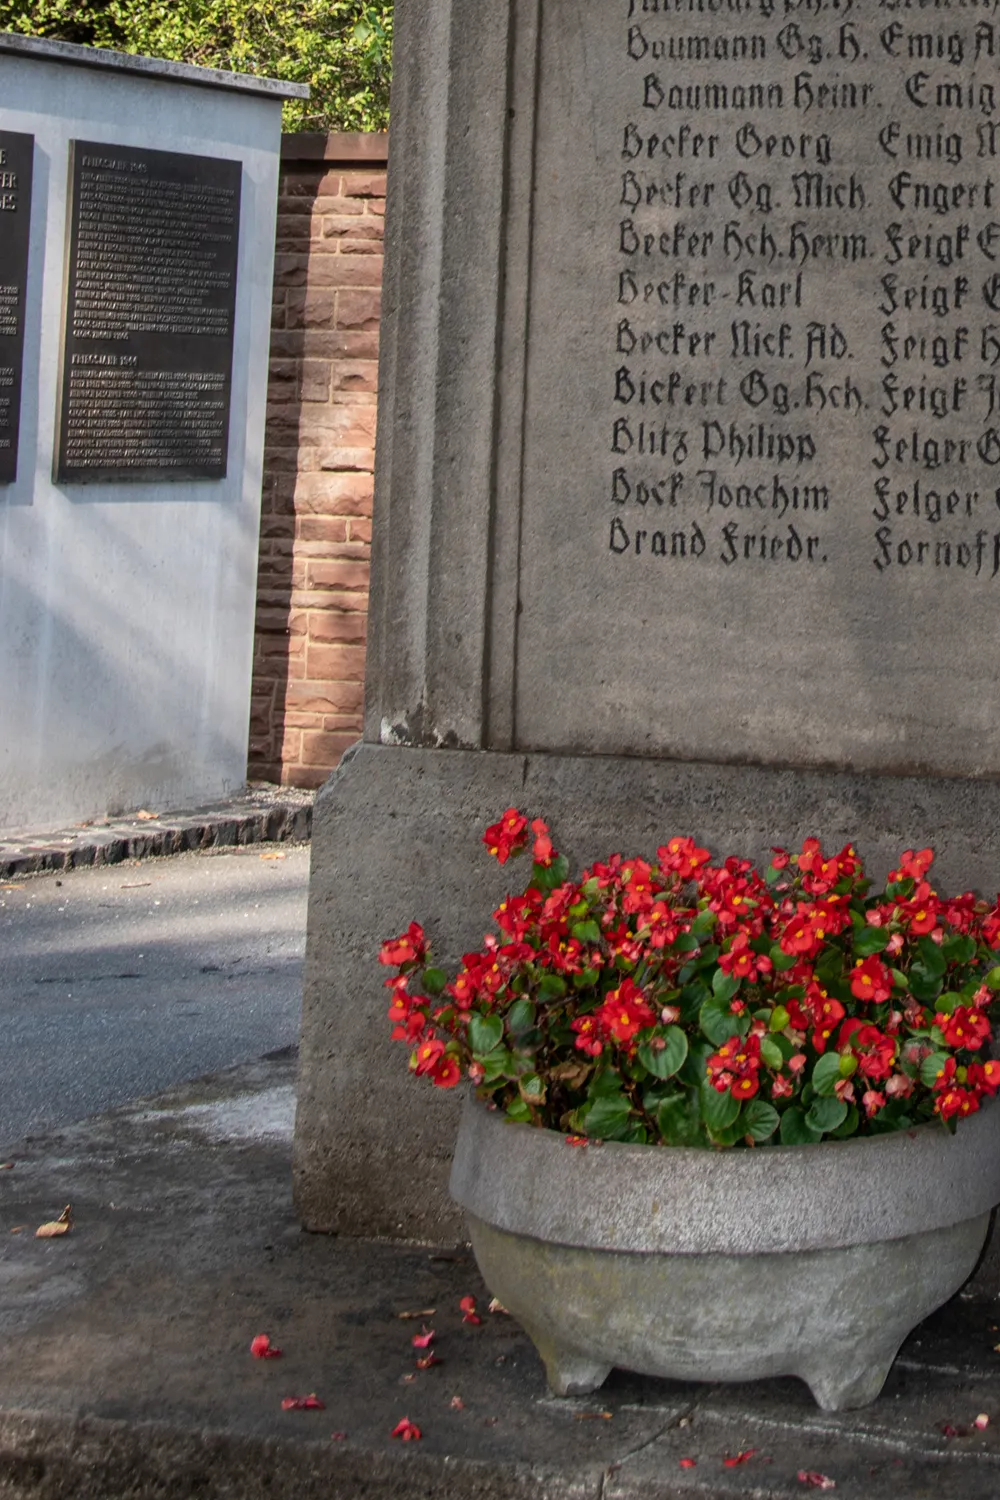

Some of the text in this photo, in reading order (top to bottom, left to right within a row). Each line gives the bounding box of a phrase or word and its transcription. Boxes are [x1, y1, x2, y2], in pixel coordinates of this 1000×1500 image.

[627, 25, 766, 61] Baumann
[880, 21, 964, 65] Emig
[643, 71, 882, 114] Baumann Heinr.
[905, 71, 996, 116] Emig
[622, 122, 832, 166] Becker Georg
[879, 121, 963, 165] Emig
[621, 170, 714, 213] Becker
[888, 171, 995, 215] Engert
[618, 218, 714, 257] Becker
[735, 268, 803, 308] Karl
[616, 318, 717, 357] Becker
[614, 365, 728, 406] Bickert
[610, 415, 817, 467] Blitz Philipp
[872, 425, 972, 470] Felger
[611, 466, 829, 519] Bock Joachim
[872, 476, 979, 523] Felger
[609, 516, 706, 558] Brand
